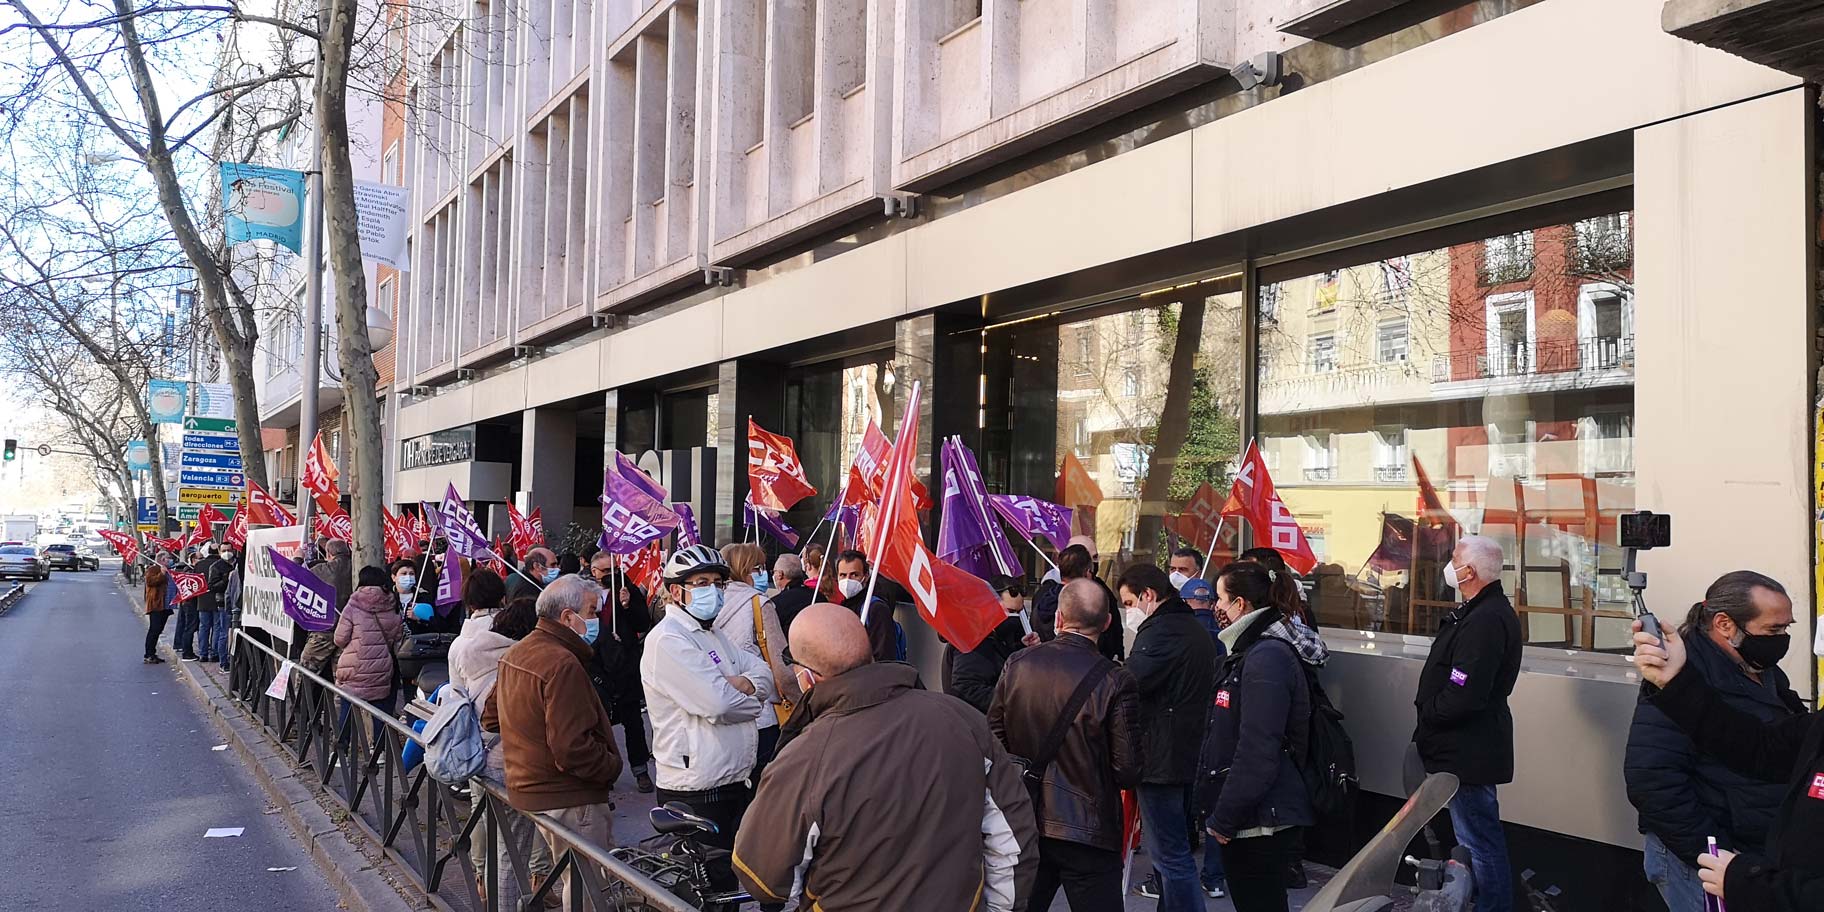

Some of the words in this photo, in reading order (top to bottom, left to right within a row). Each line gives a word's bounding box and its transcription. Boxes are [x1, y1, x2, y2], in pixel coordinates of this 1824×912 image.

[258, 182, 294, 194] Festival
[255, 231, 287, 243] MADRID
[365, 229, 386, 239] Pablo
[184, 441, 224, 449] direcciones
[183, 455, 217, 464] Zaragoza
[182, 474, 214, 482] Valencia
